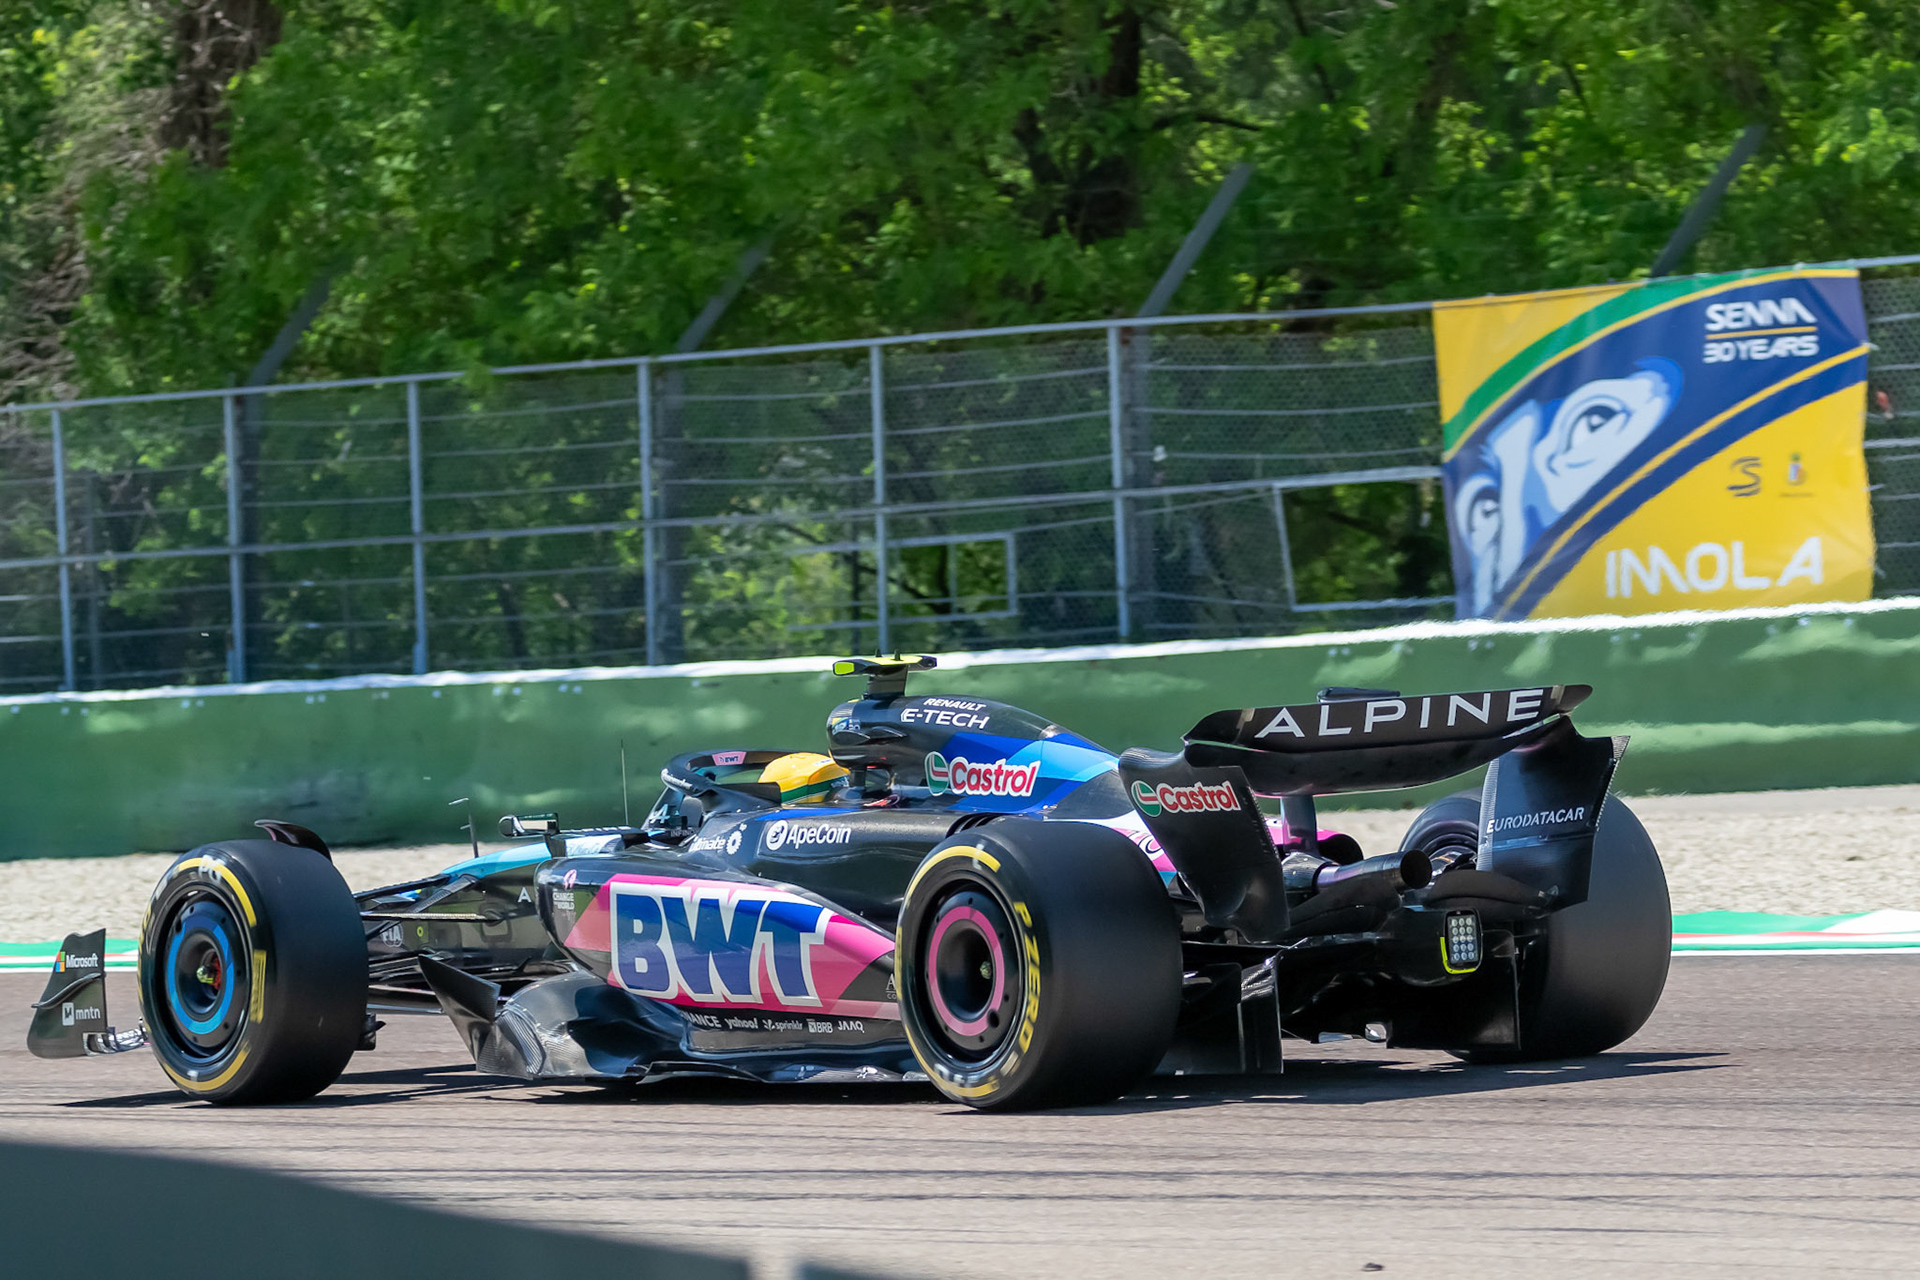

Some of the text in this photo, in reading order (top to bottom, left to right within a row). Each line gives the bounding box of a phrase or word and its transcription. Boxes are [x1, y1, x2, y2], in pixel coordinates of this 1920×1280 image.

[1705, 297, 1817, 331] SENNA
[1703, 335, 1819, 363] 30 YEARS
[1605, 536, 1824, 598] IMOLA
[923, 698, 987, 711] RENAULT
[1254, 689, 1543, 738] ALPINE
[900, 708, 990, 729] E-TECH
[950, 758, 1040, 796] Castrol
[1158, 782, 1240, 812] Castrol
[1486, 807, 1584, 834] EURODATACAR
[786, 824, 851, 849] ApeCoin
[611, 883, 832, 1006] BWT
[66, 953, 99, 968] Microsoft
[1013, 902, 1041, 1054] P ZERO
[75, 1006, 101, 1020] mntn
[724, 1016, 758, 1030] yahoo!
[817, 1022, 834, 1033] BRB
